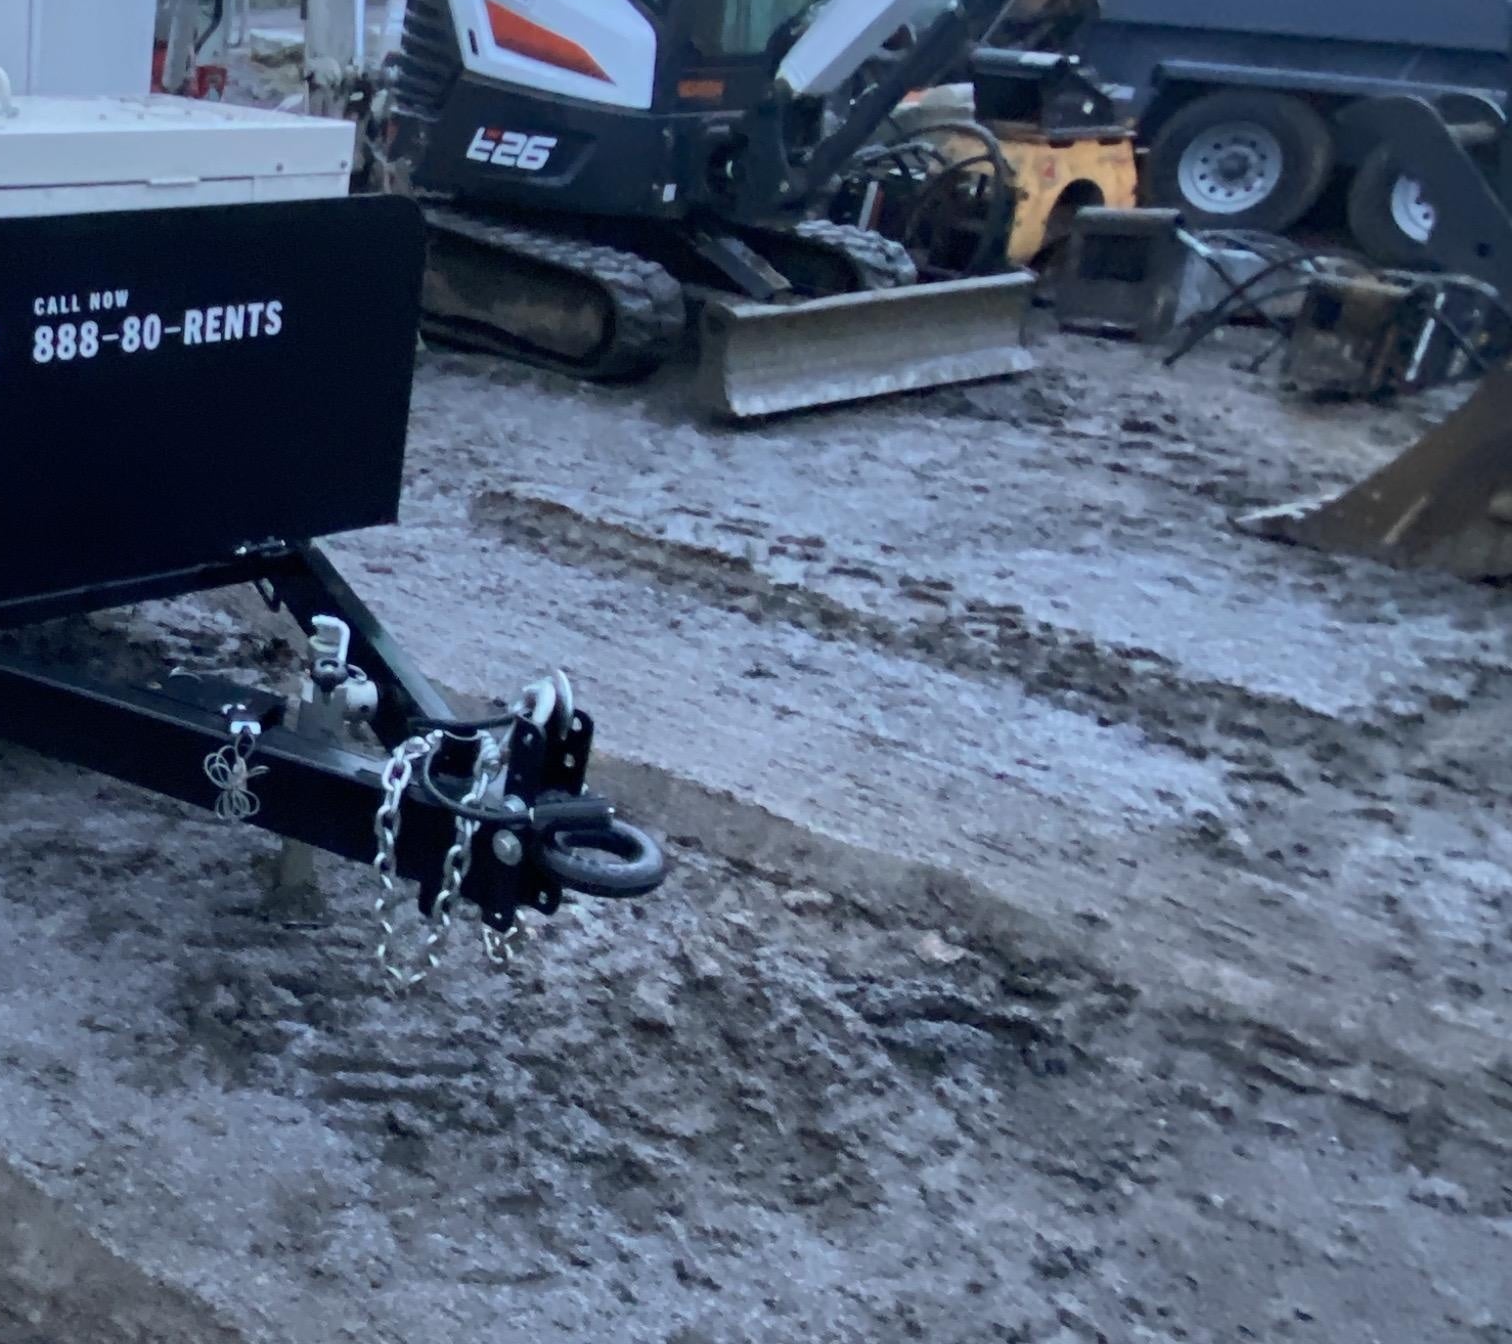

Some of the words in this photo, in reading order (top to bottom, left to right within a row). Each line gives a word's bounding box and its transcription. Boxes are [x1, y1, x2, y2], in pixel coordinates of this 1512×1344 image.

[466, 126, 558, 171] E26
[34, 296, 80, 316] CALL
[89, 289, 129, 310] NOW
[33, 300, 283, 364] 888-80-RENTS
